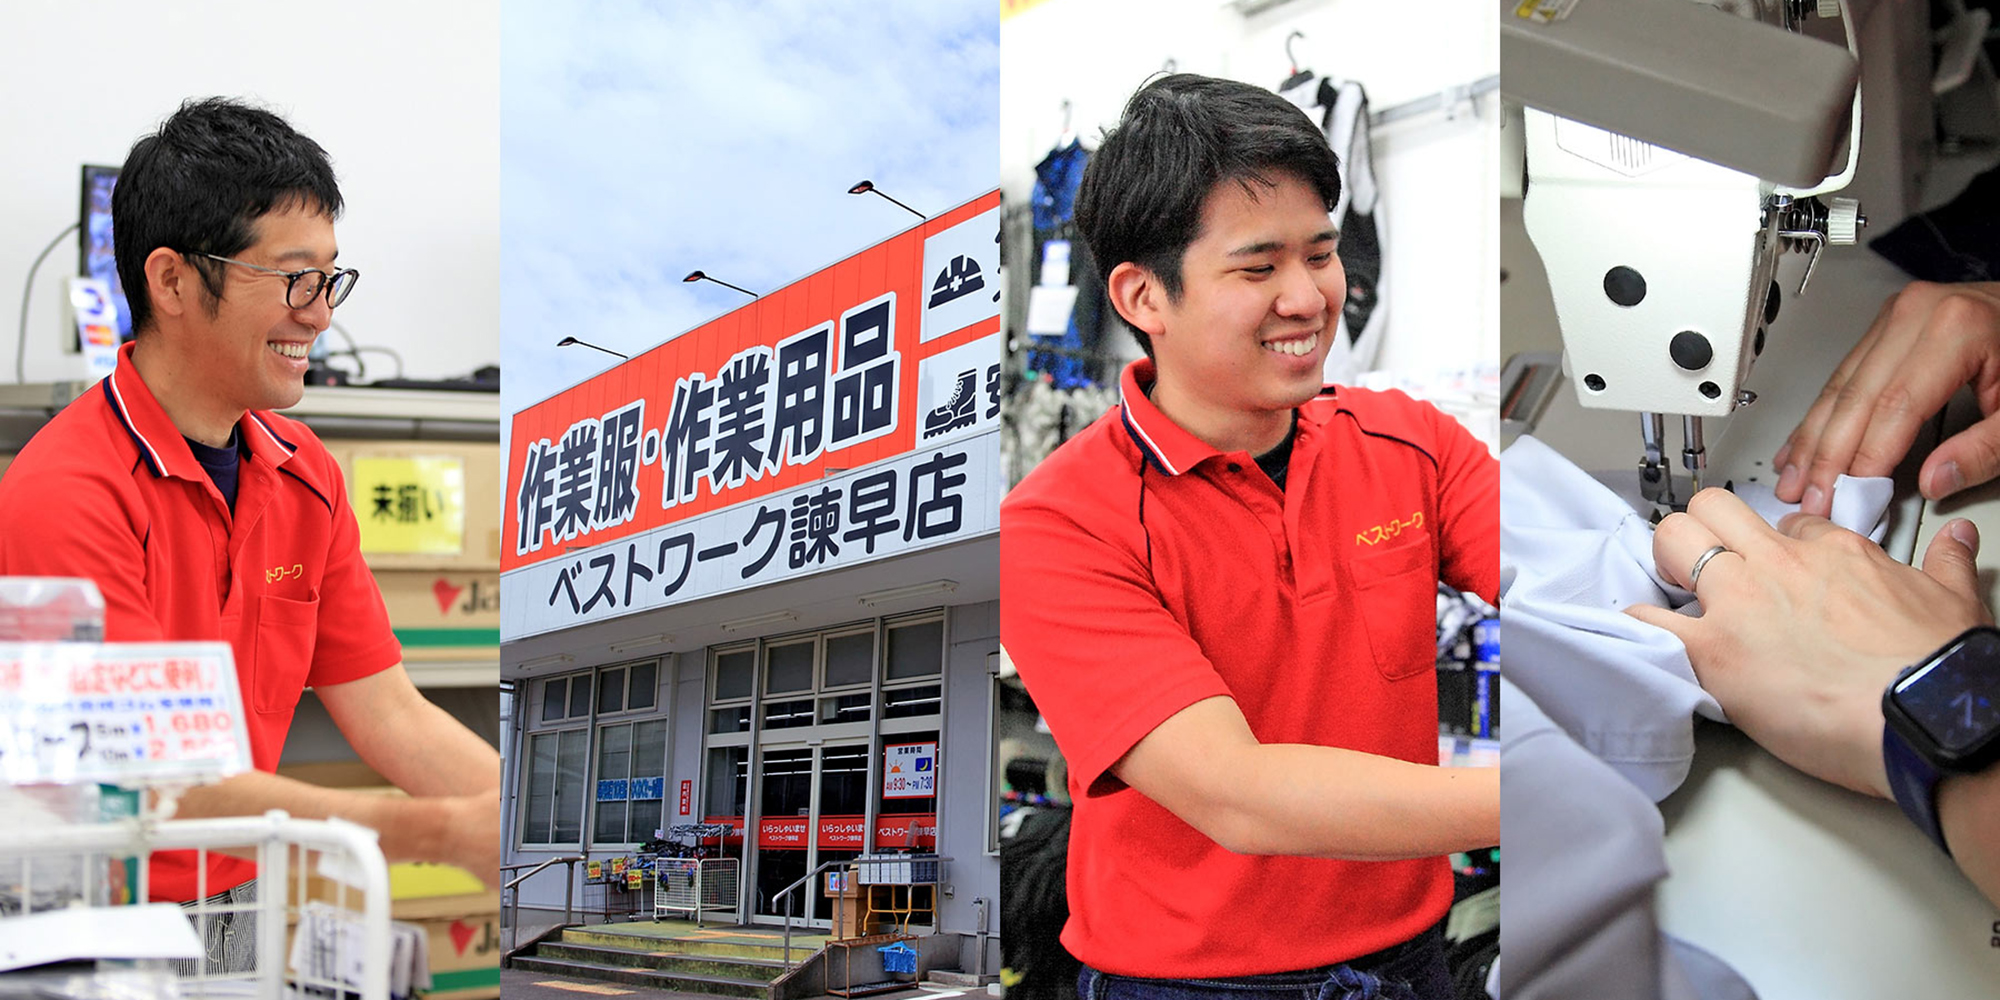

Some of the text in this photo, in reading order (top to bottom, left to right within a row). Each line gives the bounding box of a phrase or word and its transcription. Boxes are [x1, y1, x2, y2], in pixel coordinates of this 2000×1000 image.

[548, 452, 967, 615] ベストワーク諫早店
[1356, 511, 1424, 546] ベストワーク
[762, 824, 806, 834] いらっしゃいませ
